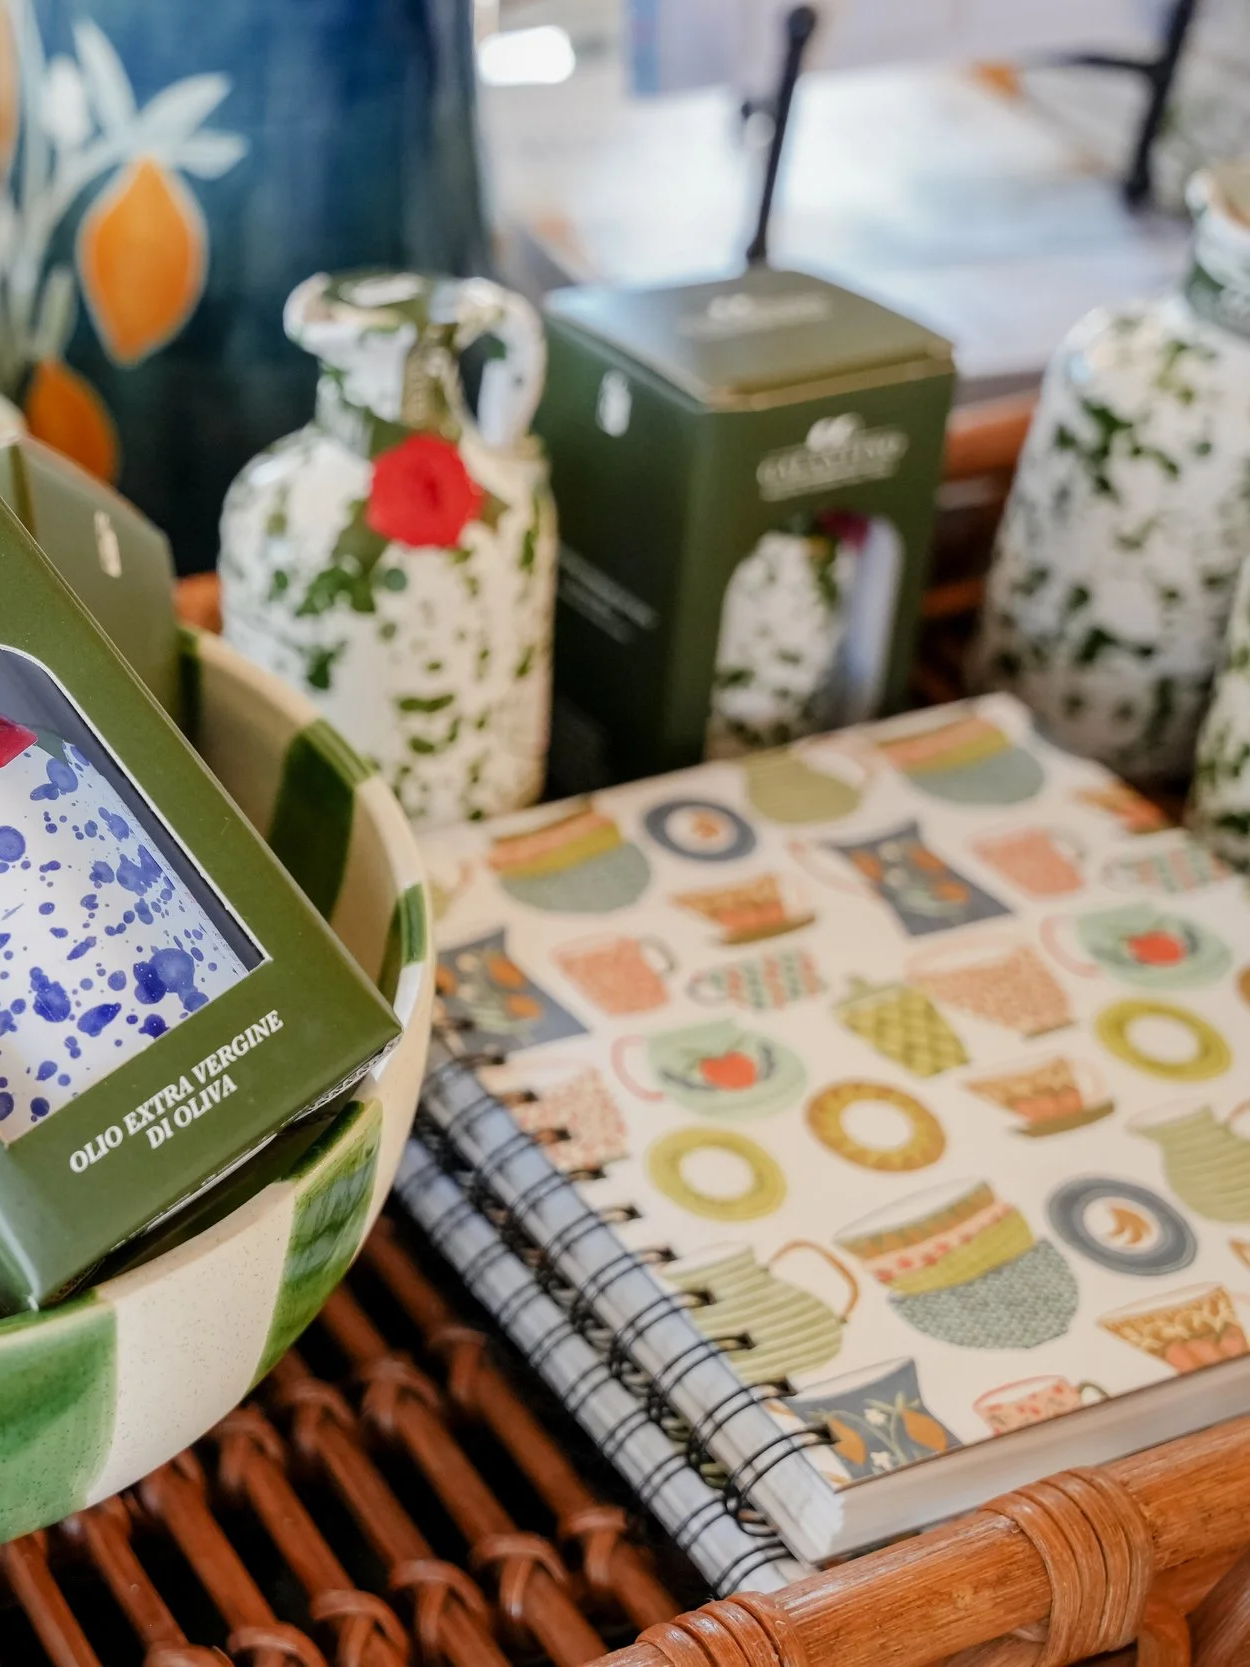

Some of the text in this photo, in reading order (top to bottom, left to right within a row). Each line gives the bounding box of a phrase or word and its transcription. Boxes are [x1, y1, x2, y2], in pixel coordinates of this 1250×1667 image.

[69, 1009, 284, 1173] OLIO EXTRA VERGINE
[145, 1074, 238, 1149] DI OLIVA
